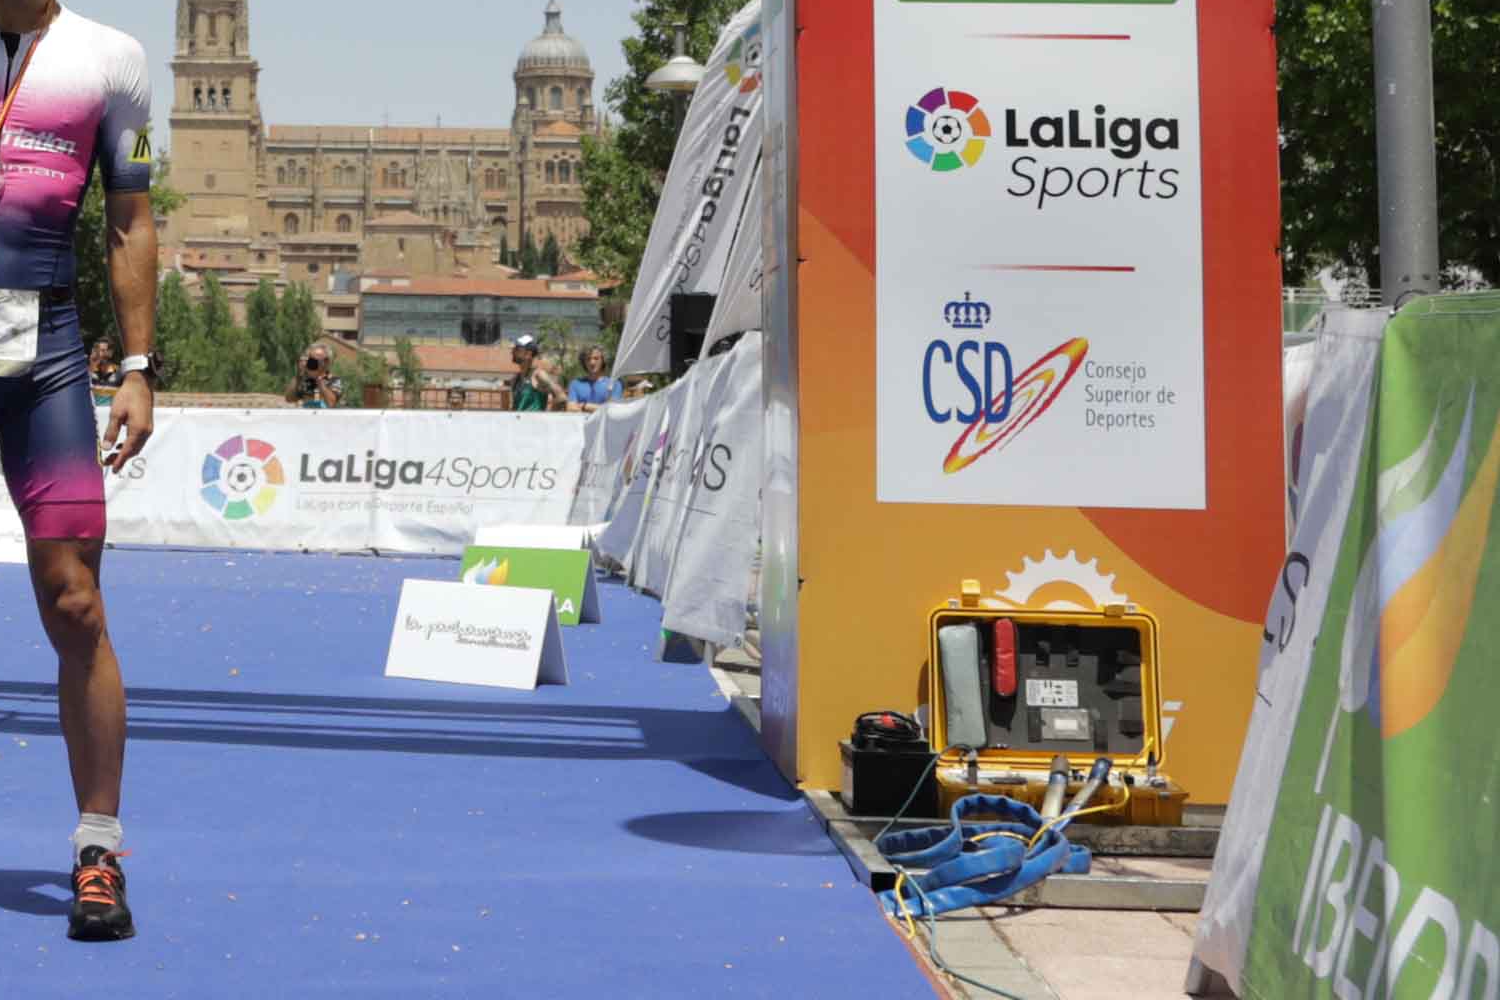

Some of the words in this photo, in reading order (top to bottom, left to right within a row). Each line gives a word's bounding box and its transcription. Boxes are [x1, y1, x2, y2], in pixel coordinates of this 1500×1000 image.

[1005, 104, 1180, 159] LaLiga
[1006, 155, 1180, 210] Sports
[922, 339, 1013, 424] CSD
[1084, 359, 1148, 381] Consejo
[1084, 385, 1150, 408] Superior
[1156, 386, 1176, 404] de
[1084, 408, 1156, 431] Deportes
[300, 449, 557, 494] LaLiga4Sports
